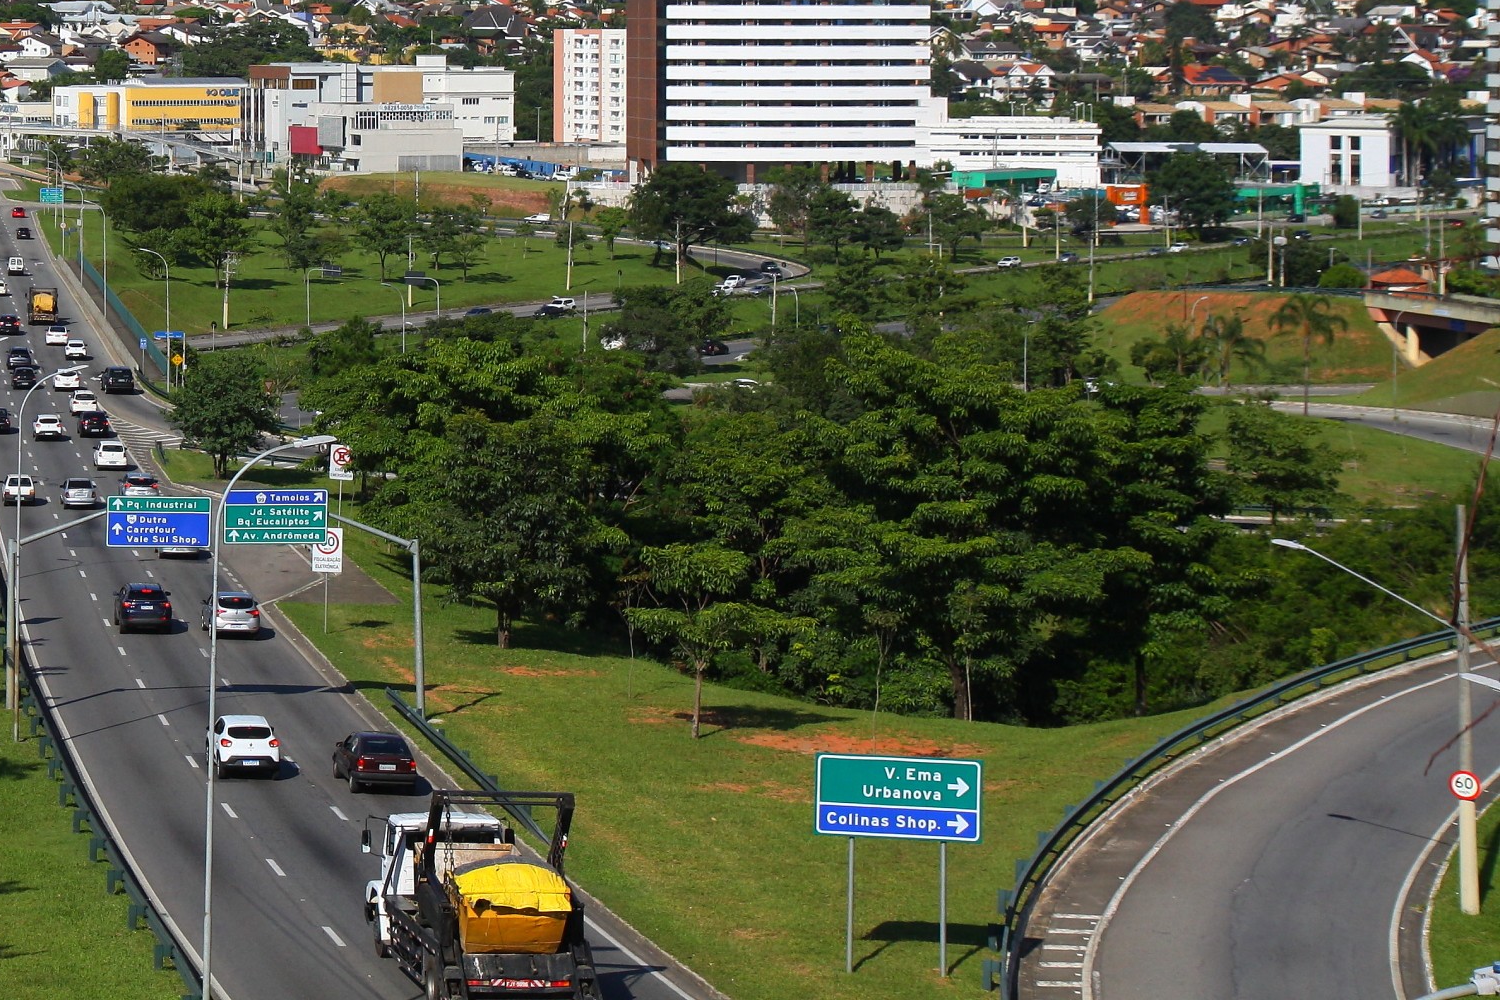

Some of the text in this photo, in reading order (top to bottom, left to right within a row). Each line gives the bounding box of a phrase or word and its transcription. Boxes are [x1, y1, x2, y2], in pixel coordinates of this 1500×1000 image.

[126, 501, 197, 509] Pq. Industrial
[250, 507, 310, 516] Jd. Satélite
[139, 516, 167, 524] Dutra
[237, 518, 310, 527] Bq. Eucaliptos
[126, 526, 176, 534] Carrefour
[126, 535, 200, 545] Vale Sul Shop.
[242, 531, 320, 540] Av. Andrômeda
[884, 766, 942, 782] V. Ema
[1455, 777, 1473, 790] 60
[862, 785, 942, 801] Urbanova
[826, 811, 941, 832] Colinas Shop.
